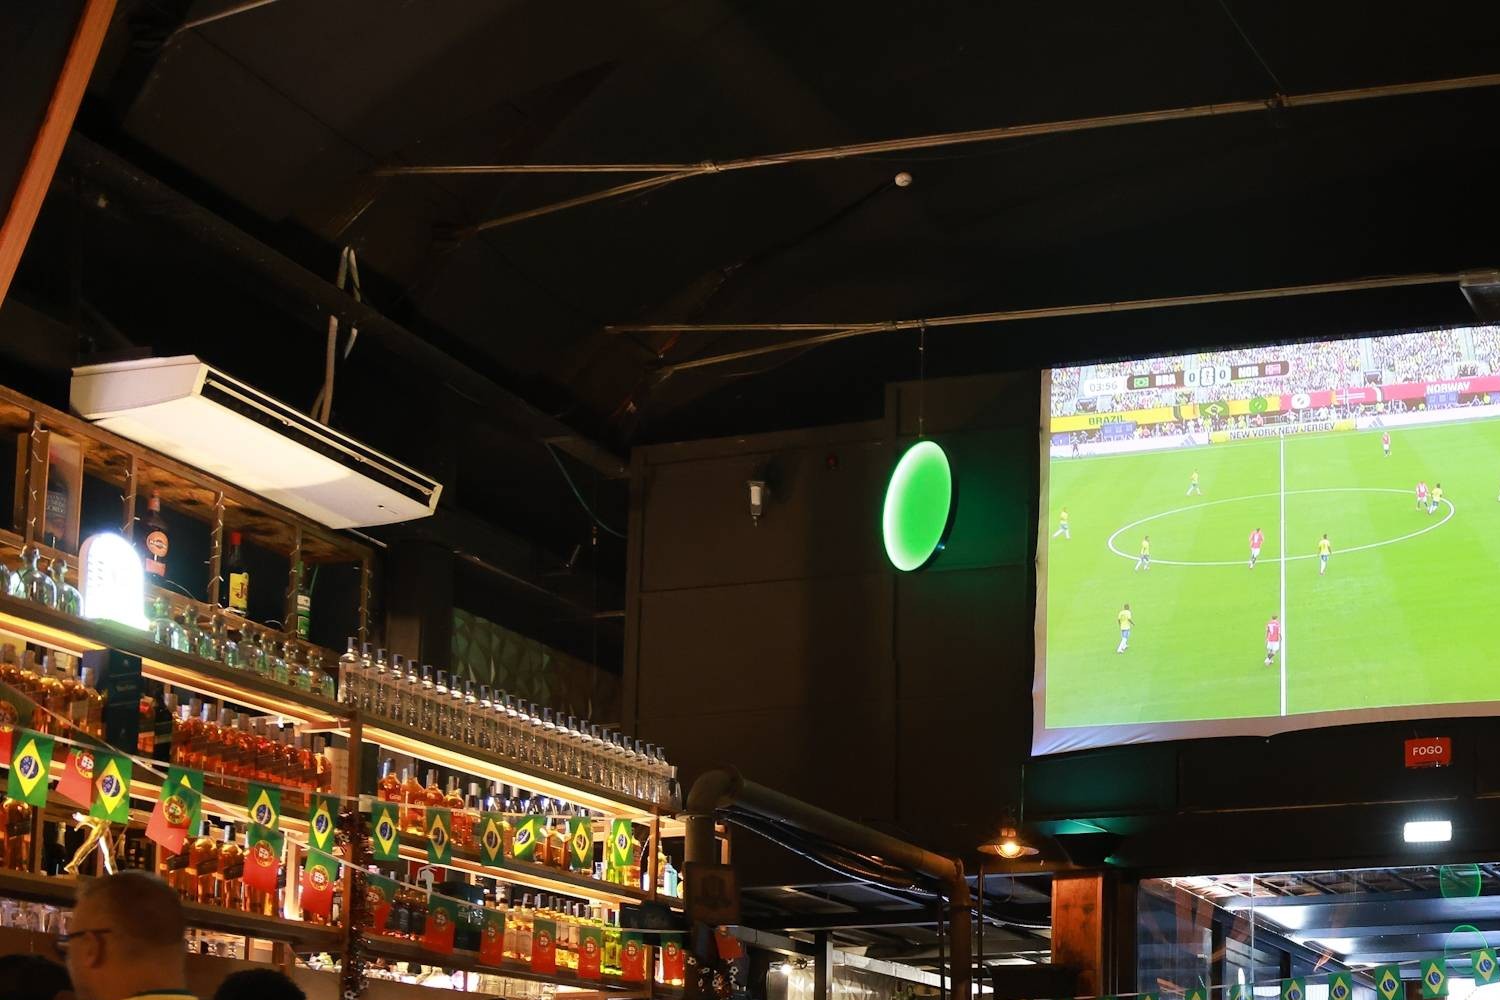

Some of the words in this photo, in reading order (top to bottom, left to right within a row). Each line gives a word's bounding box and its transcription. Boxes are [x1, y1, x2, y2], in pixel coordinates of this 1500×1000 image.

[1188, 374, 1196, 383] 0
[1219, 369, 1226, 379] 0
[1089, 381, 1118, 392] 03:56
[1426, 381, 1470, 394] NORWAY
[1088, 414, 1125, 426] BRAZIL
[1230, 431, 1249, 439] NEW
[1253, 429, 1276, 437] YORK
[1279, 426, 1298, 435] NEW
[1300, 423, 1335, 433] JERSEY
[1412, 745, 1443, 757] FOGO
